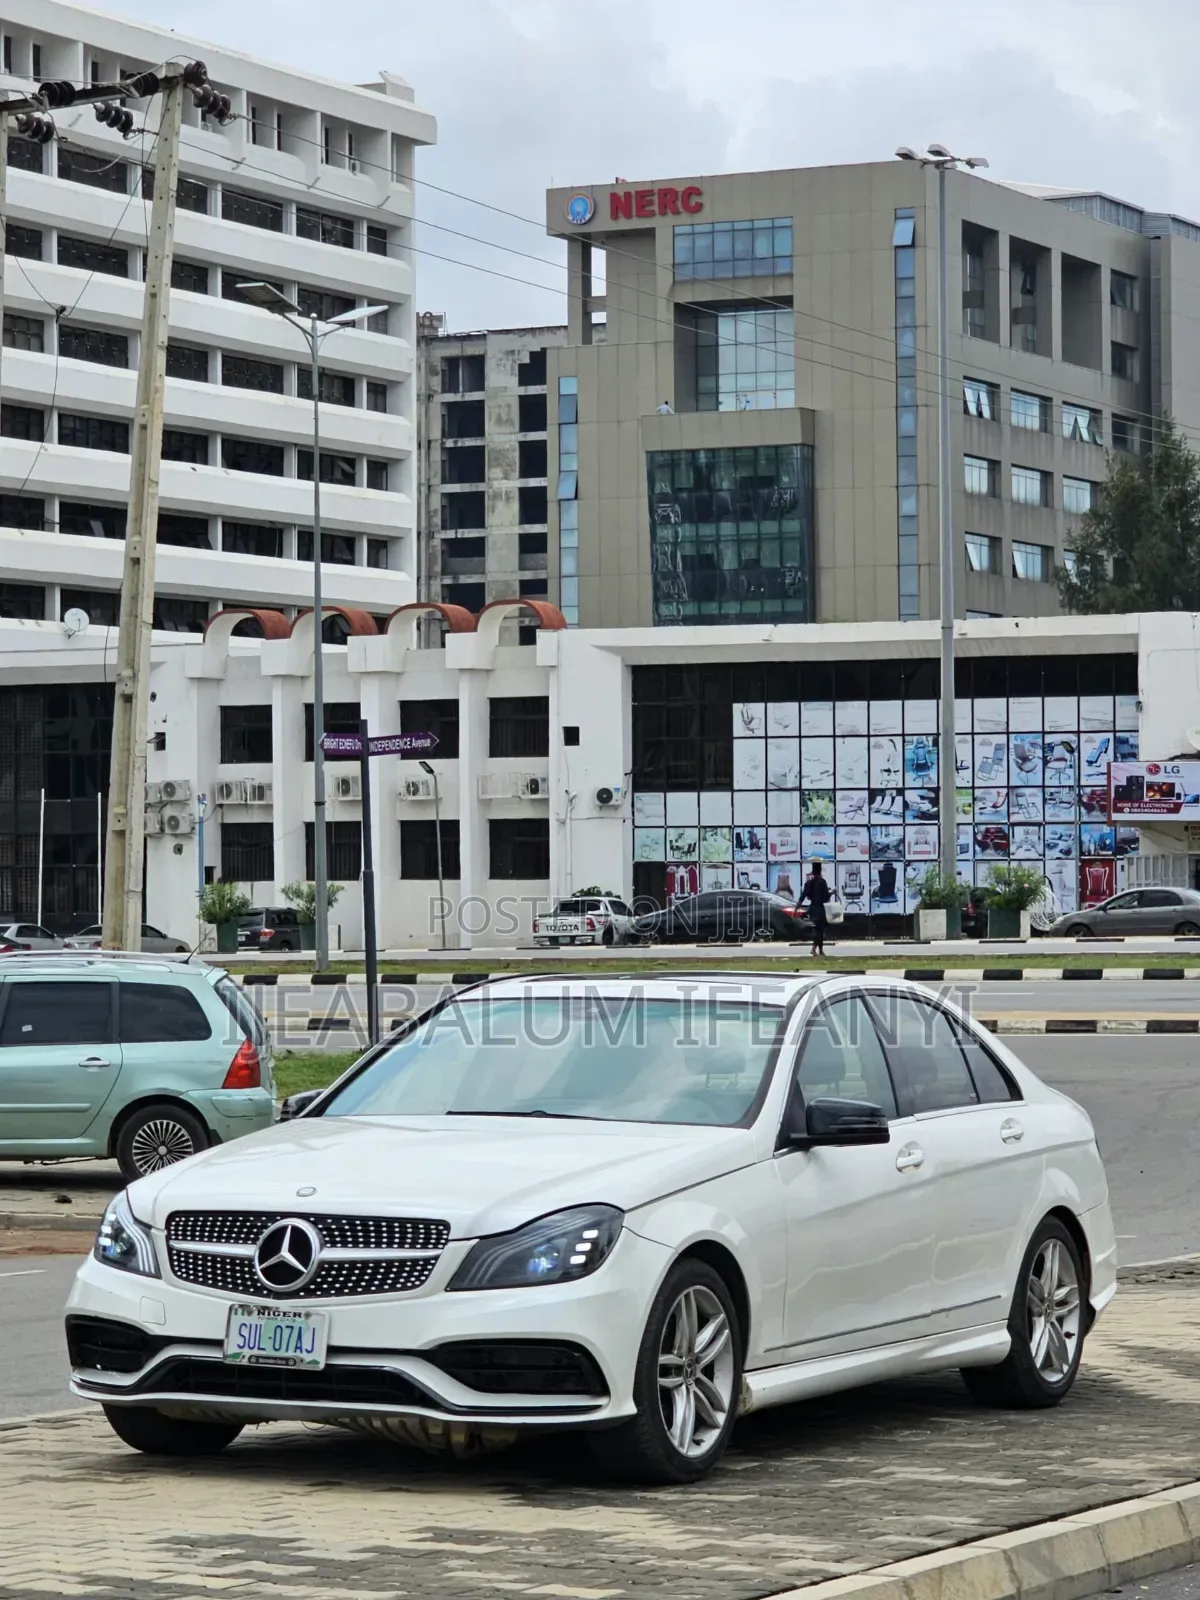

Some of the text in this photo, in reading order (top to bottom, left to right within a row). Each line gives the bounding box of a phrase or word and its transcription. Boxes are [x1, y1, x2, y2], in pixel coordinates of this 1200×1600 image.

[609, 186, 704, 221] NERC
[323, 738, 338, 749] BRIGHT
[369, 737, 431, 752] INDEPENDENCE Avenue
[1164, 765, 1180, 774] LG
[545, 924, 580, 932] TOYOTA
[257, 1309, 302, 1318] NIGER
[236, 1322, 316, 1354] SUL-07AJ
